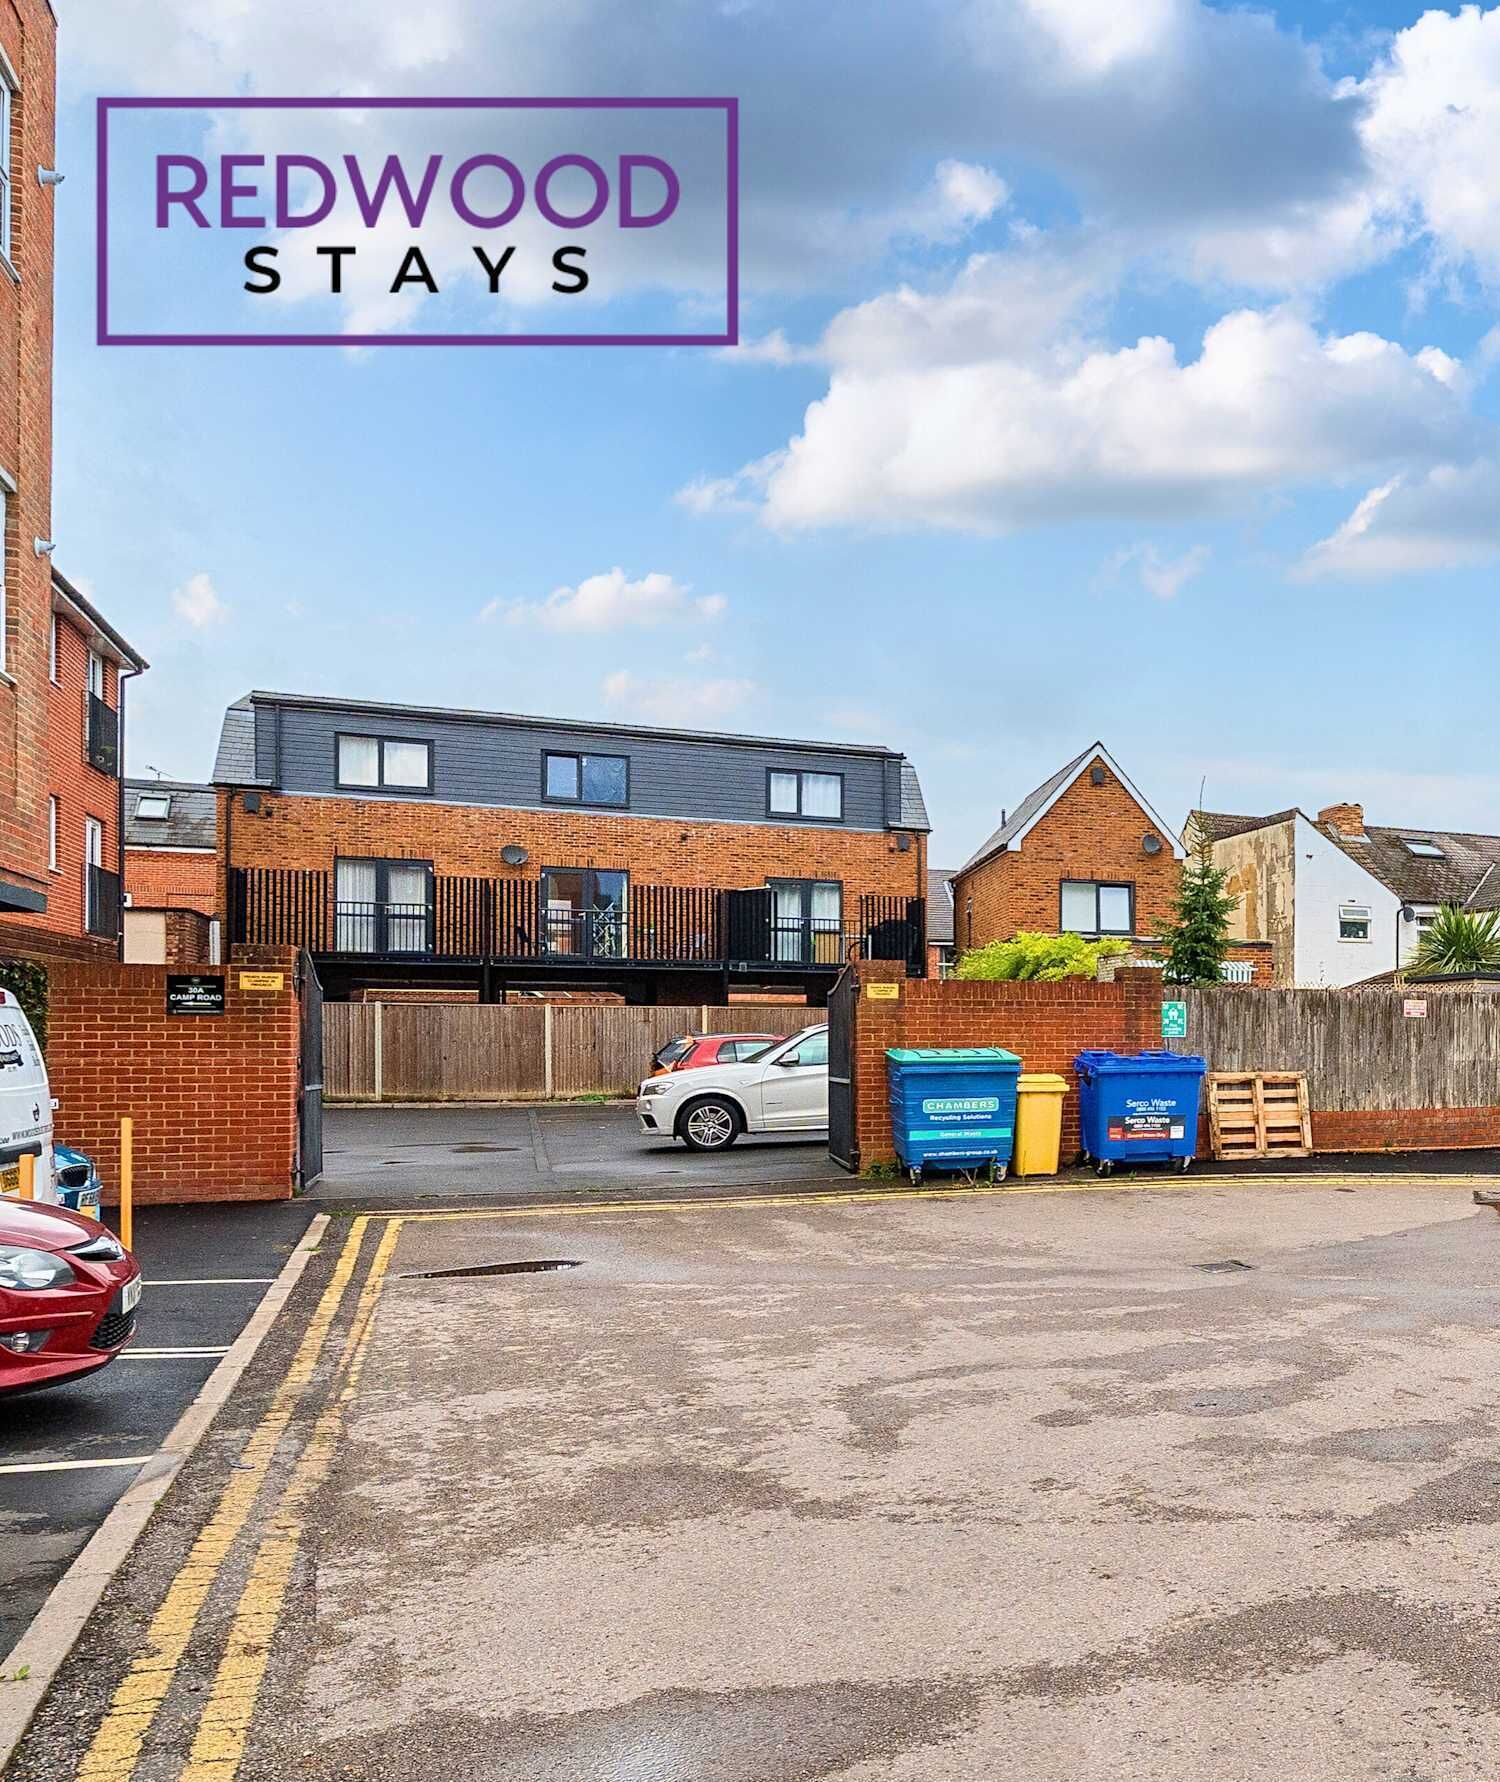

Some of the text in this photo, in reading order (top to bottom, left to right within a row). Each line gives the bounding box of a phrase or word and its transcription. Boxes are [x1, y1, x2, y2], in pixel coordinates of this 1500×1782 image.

[927, 1101, 995, 1110] CHAMBERS
[1126, 1098, 1176, 1108] Serco Waste
[1124, 1116, 1170, 1124] Serco Waste
